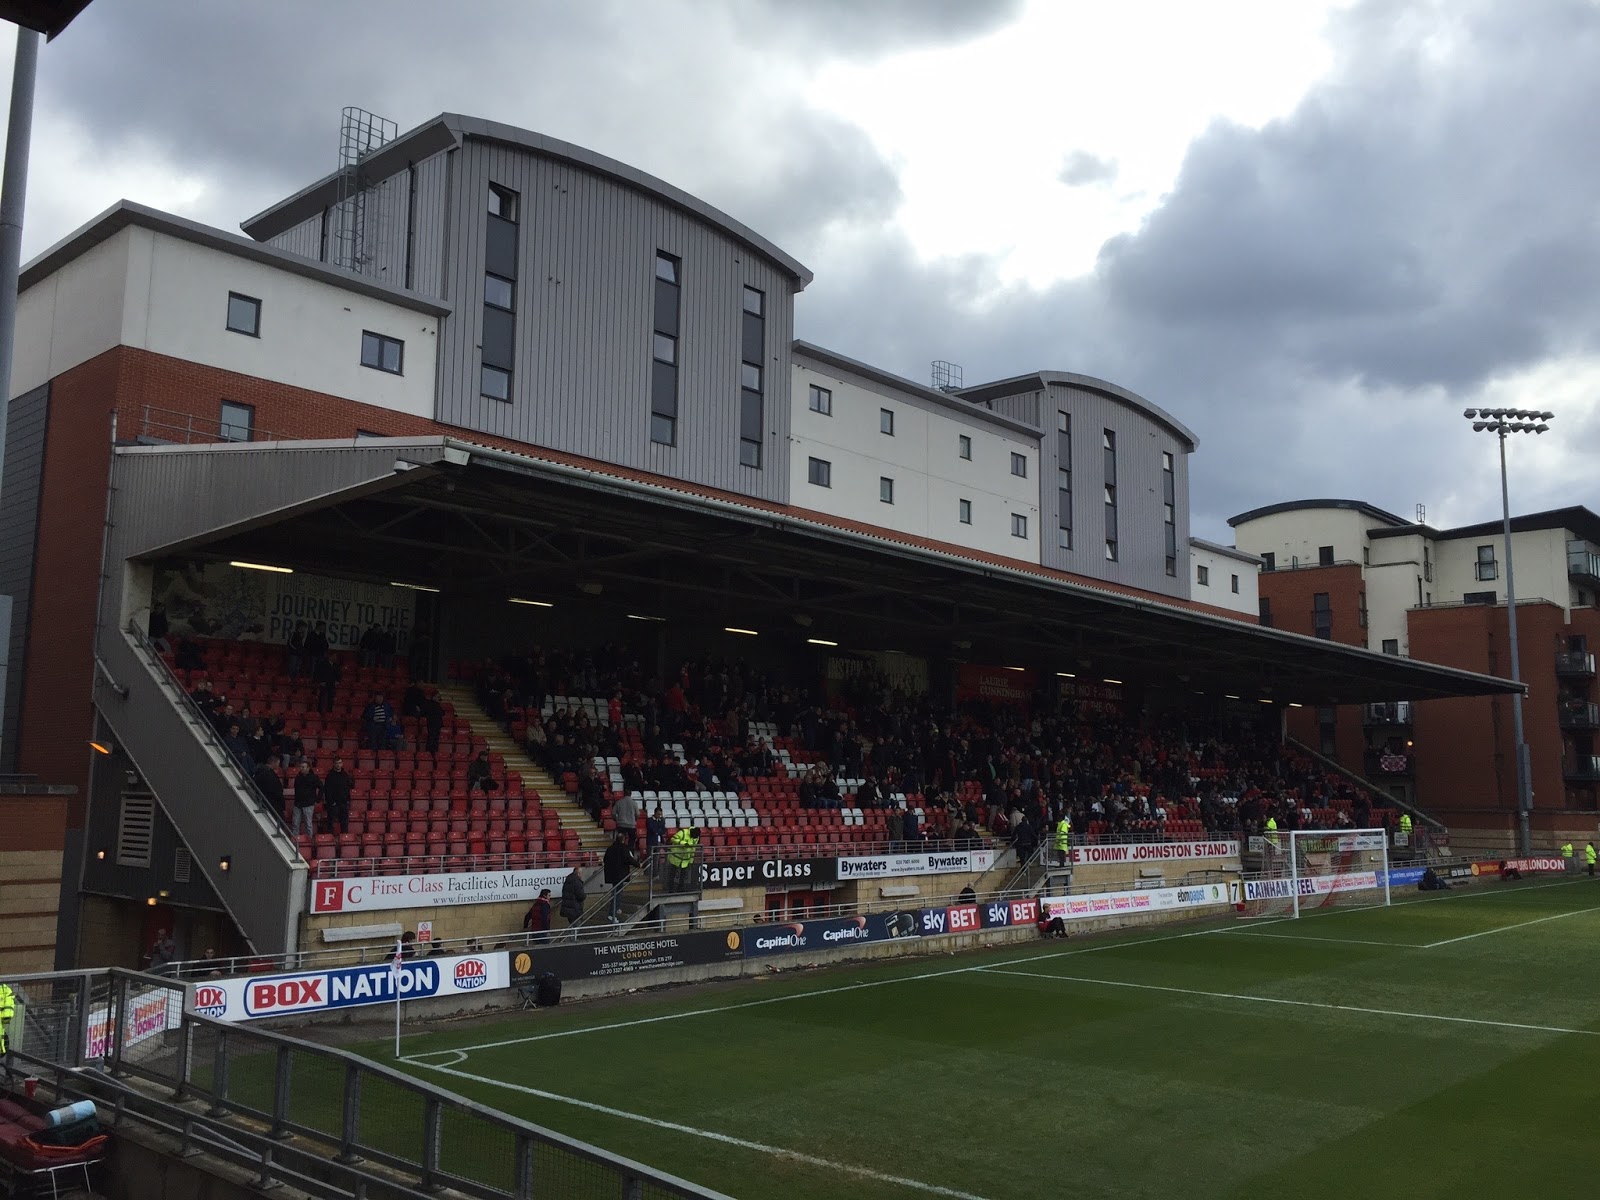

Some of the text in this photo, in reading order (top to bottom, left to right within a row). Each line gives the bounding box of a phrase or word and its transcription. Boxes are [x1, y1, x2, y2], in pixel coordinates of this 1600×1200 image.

[276, 573, 304, 595] THE
[309, 575, 359, 601] SPIRIT
[271, 593, 409, 628] JOURNEY TO THE
[271, 616, 359, 646] PRSED
[1084, 847, 1128, 862] TOMMY
[1133, 844, 1193, 861] JOHNSTON
[1195, 843, 1228, 857] STAND
[841, 859, 887, 875] Bywaters
[928, 855, 968, 870] Bywaters
[1529, 858, 1565, 870] LONDON
[698, 859, 811, 887] Saper Glass
[371, 879, 403, 897] First
[408, 877, 443, 895] Class
[447, 874, 499, 894] Facilities
[1177, 887, 1206, 903] ebmpapst
[1231, 883, 1238, 901] 7
[1247, 880, 1289, 899] RAINHAM
[323, 885, 362, 906] F C
[433, 890, 518, 905] www.firstclassfm.com
[923, 908, 977, 933] sky BET
[988, 902, 1036, 926] sky BET
[594, 939, 679, 956] THE WESTBRIDGE HOTEL
[622, 950, 653, 960] LONDON
[455, 960, 484, 978] BOX
[253, 966, 433, 1010] BOX NATION
[455, 975, 486, 989] NATION
